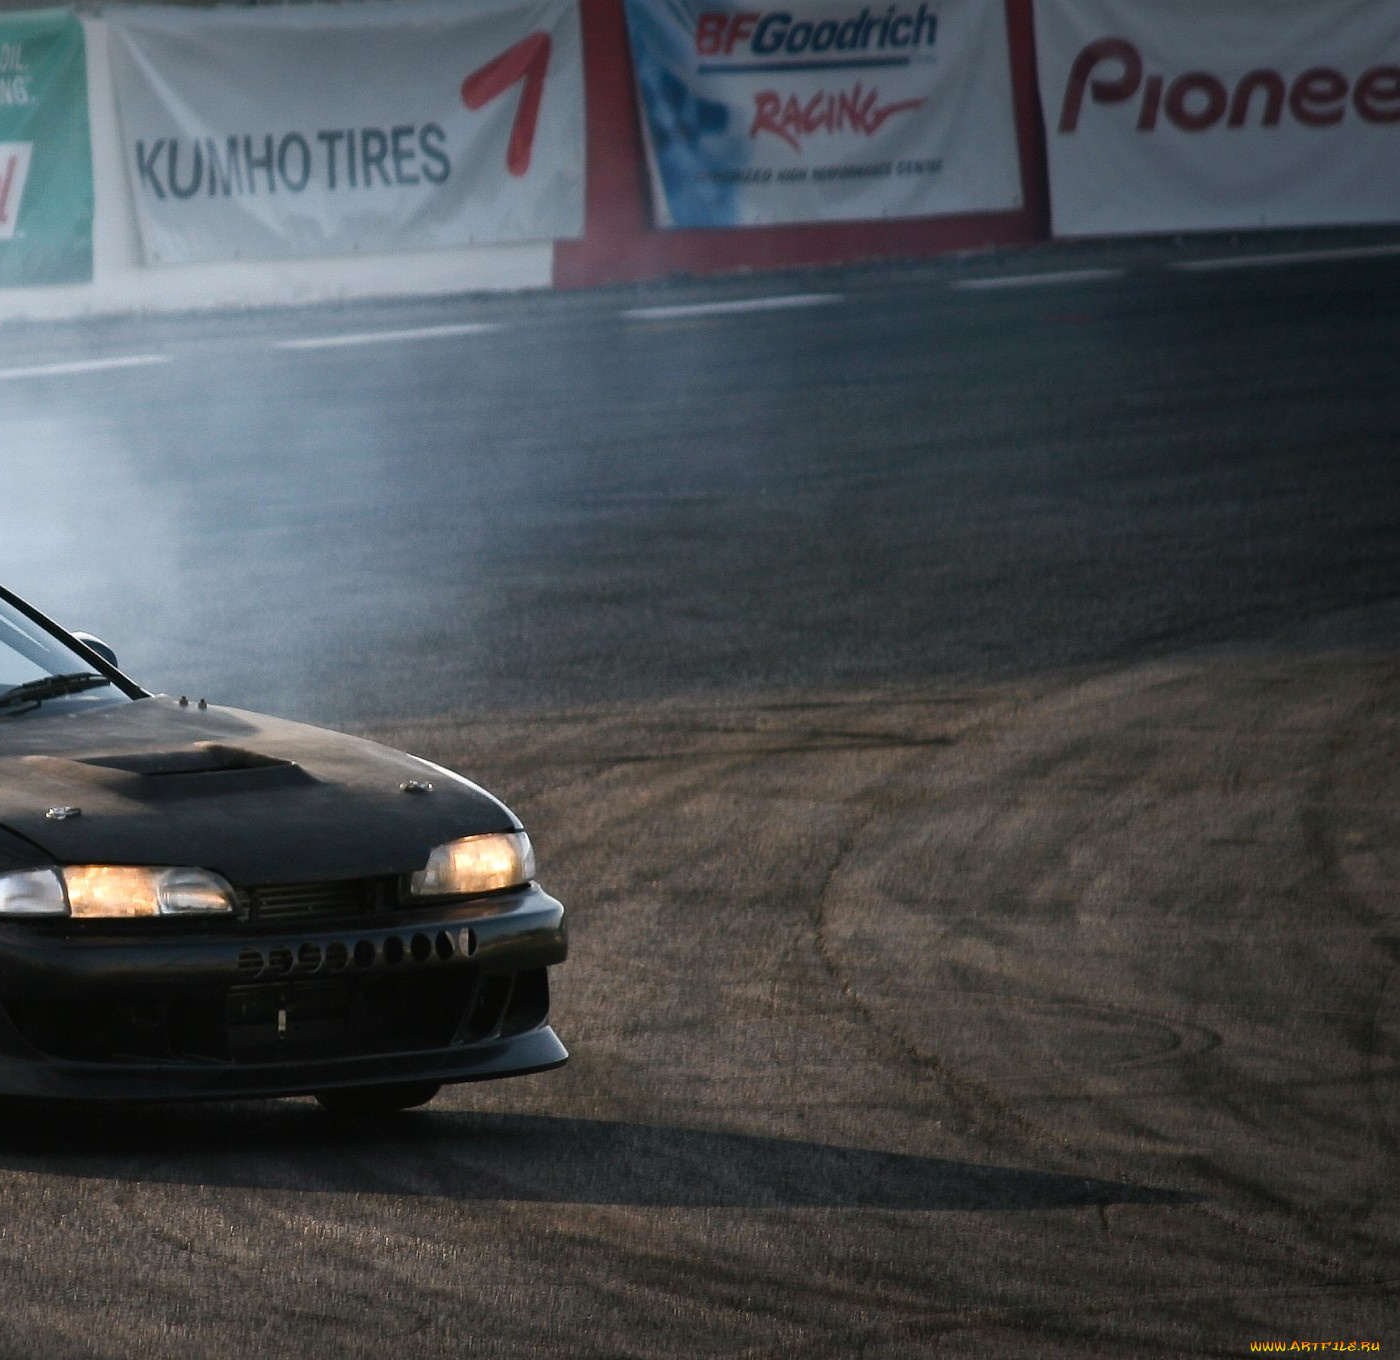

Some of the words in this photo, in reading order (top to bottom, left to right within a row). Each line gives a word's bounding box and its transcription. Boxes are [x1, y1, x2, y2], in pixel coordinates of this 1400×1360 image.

[693, 4, 938, 56] BFGoodrich
[750, 79, 930, 154] RACING
[136, 131, 311, 200] KUMHO
[316, 121, 451, 190] TIRES
